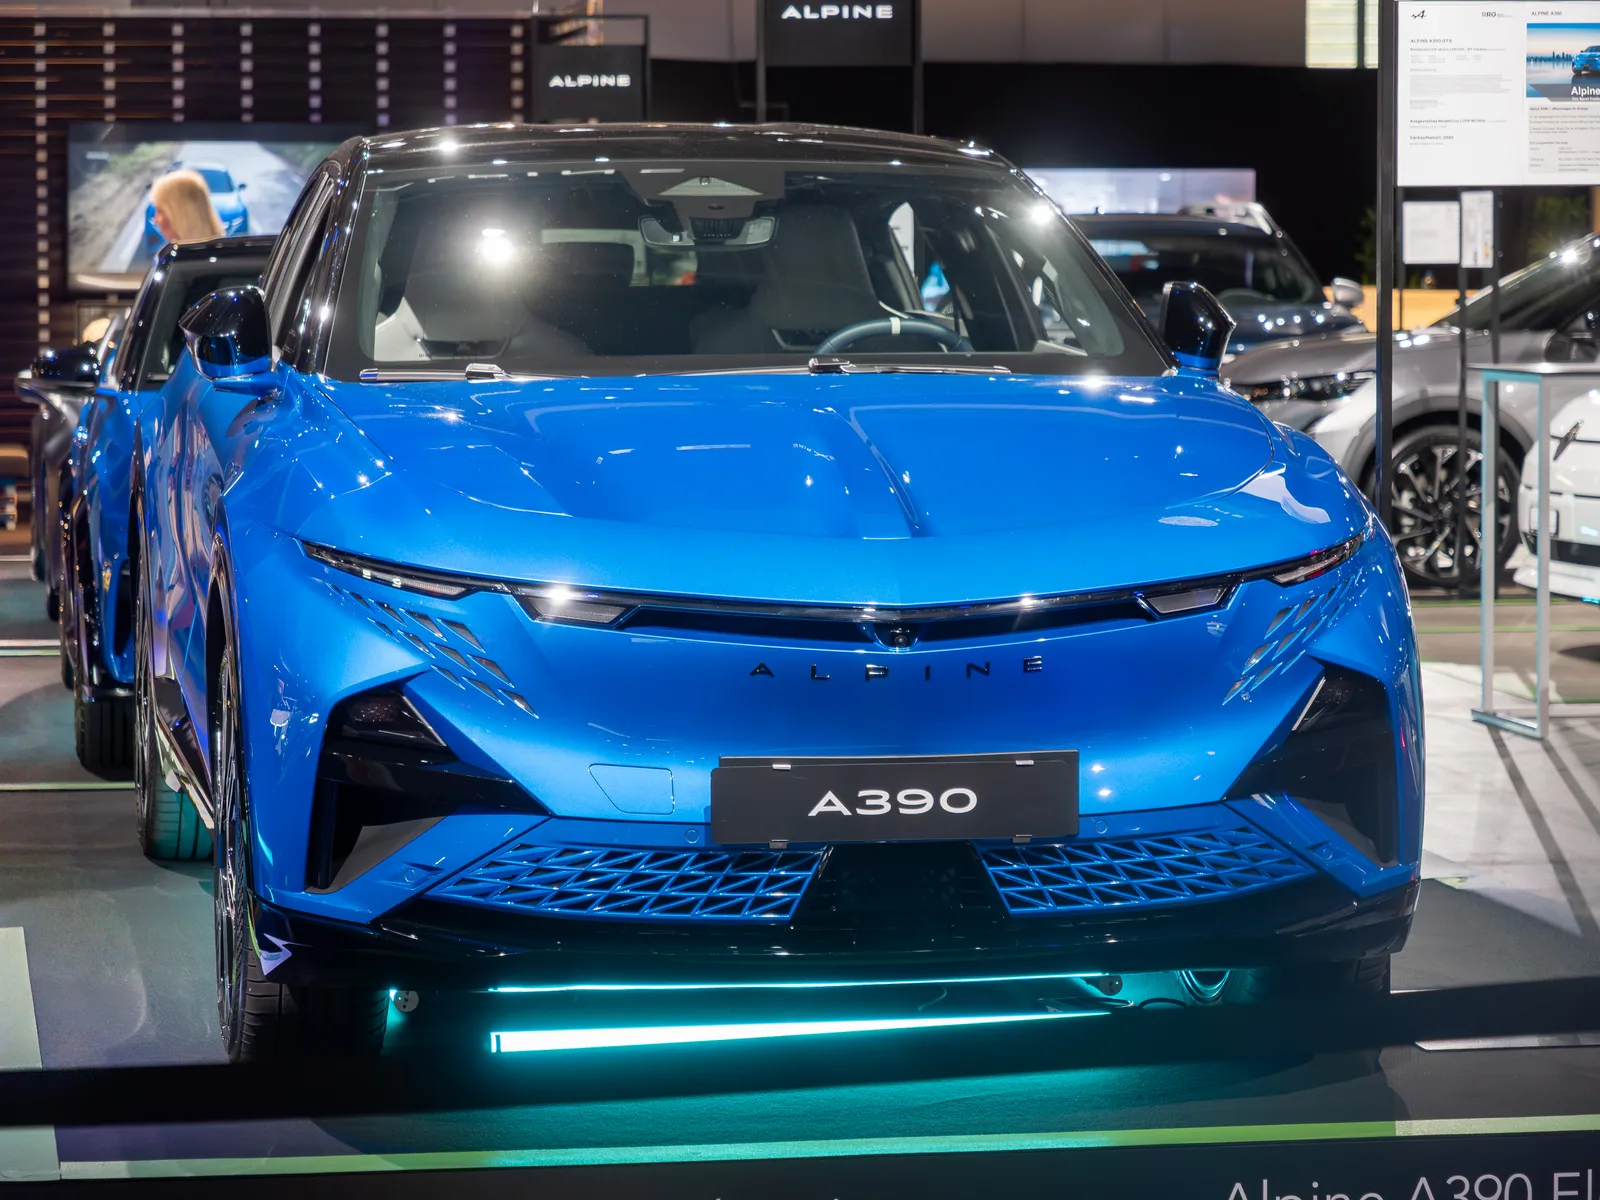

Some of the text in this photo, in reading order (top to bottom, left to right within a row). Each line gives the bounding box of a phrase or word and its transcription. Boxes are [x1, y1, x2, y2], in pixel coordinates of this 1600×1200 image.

[781, 5, 893, 19] ALPINE
[549, 74, 631, 88] ALPINE
[1570, 86, 1600, 97] Alpine
[749, 655, 1043, 682] ALPINE
[807, 787, 978, 816] A390
